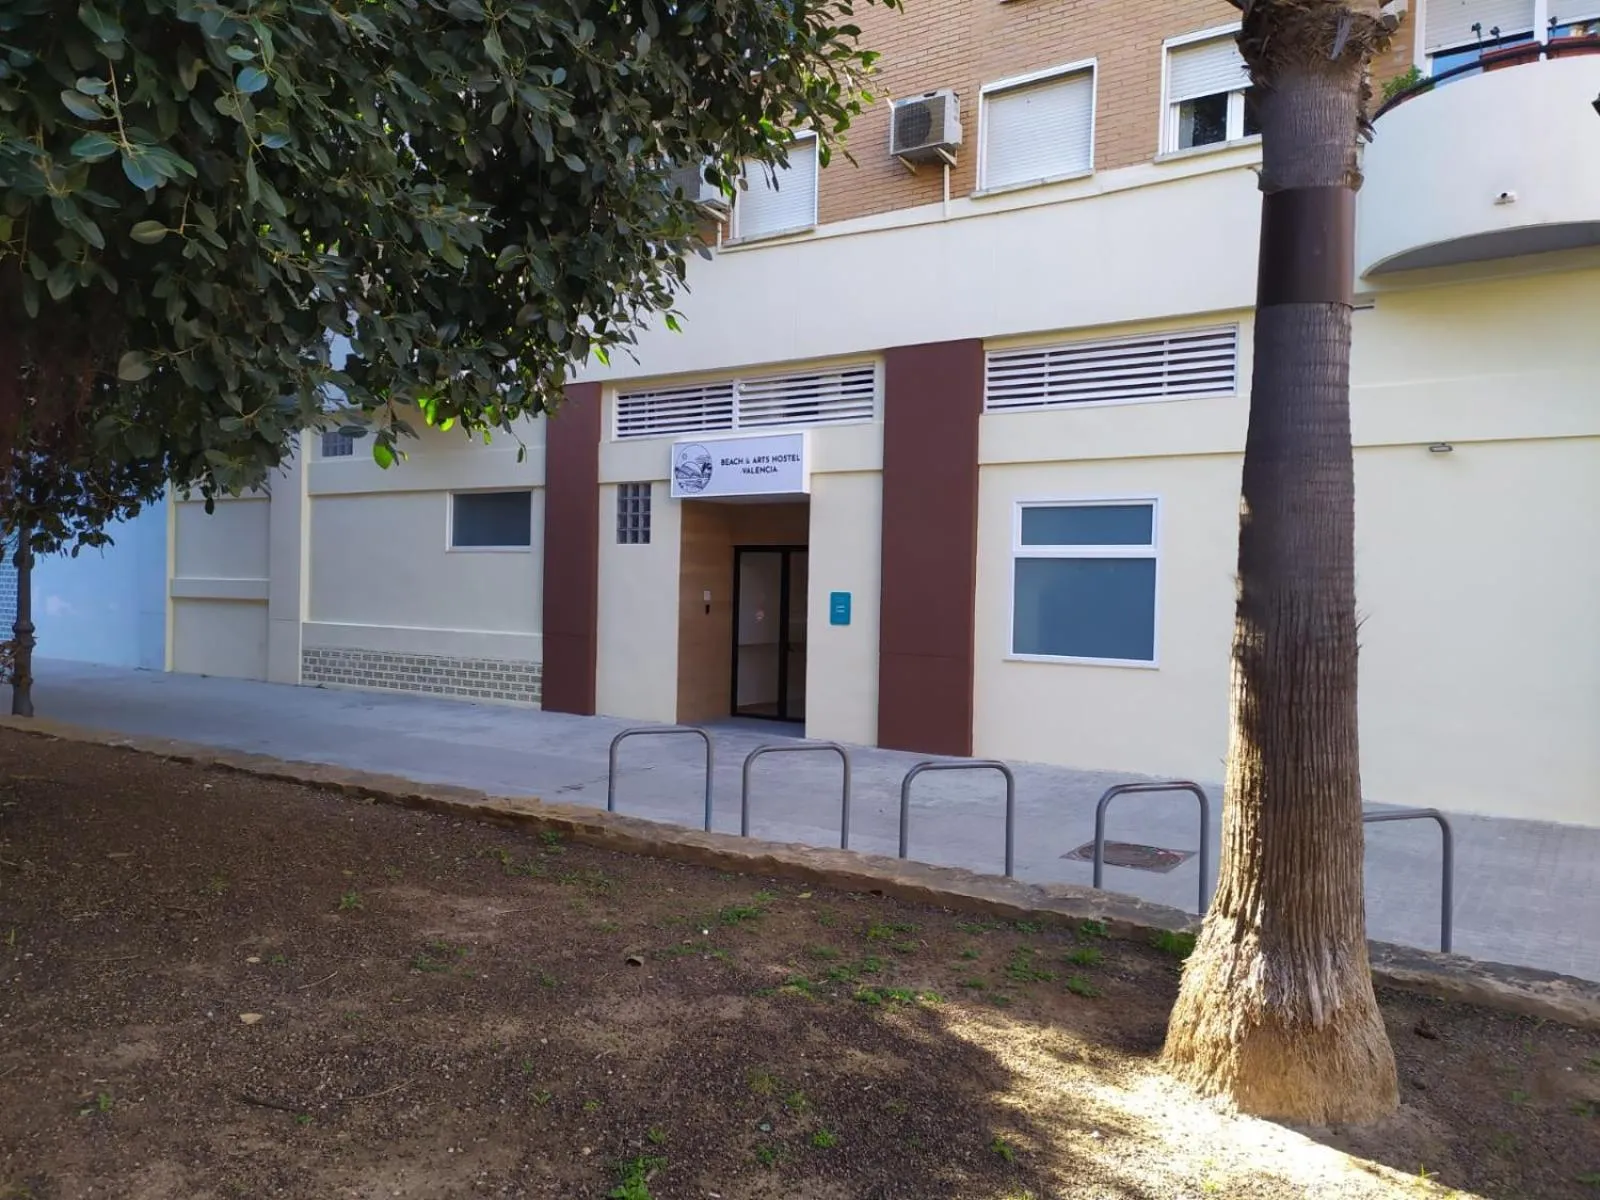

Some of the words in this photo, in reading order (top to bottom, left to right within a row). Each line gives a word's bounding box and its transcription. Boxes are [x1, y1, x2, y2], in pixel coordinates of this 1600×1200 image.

[720, 457, 744, 466] BEACH
[752, 455, 770, 464] ARTS
[771, 454, 800, 464] HOSTEL
[742, 465, 778, 474] VALENCIA
